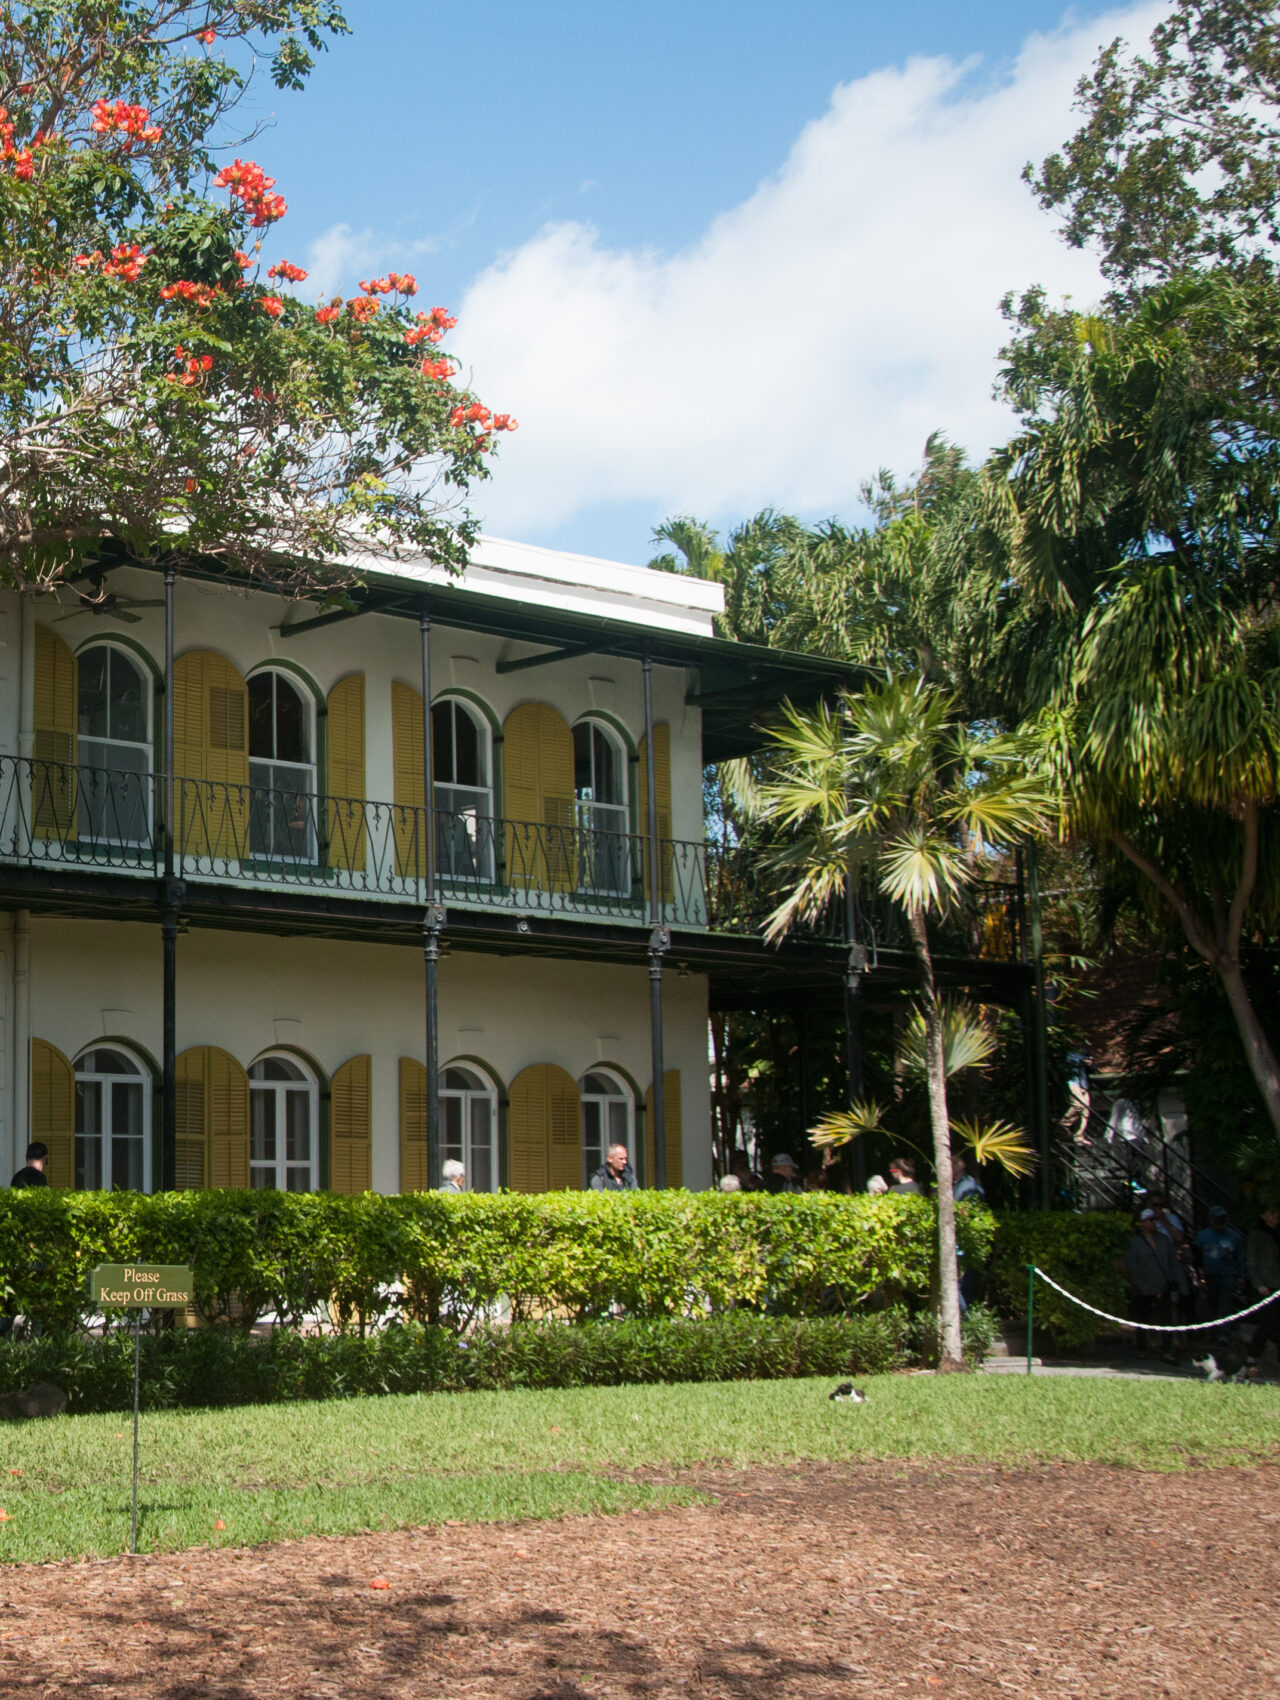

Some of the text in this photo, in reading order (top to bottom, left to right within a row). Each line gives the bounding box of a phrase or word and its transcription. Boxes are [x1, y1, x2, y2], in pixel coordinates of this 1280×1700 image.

[123, 1268, 160, 1283] Please
[100, 1287, 189, 1305] Keep Off Grass
